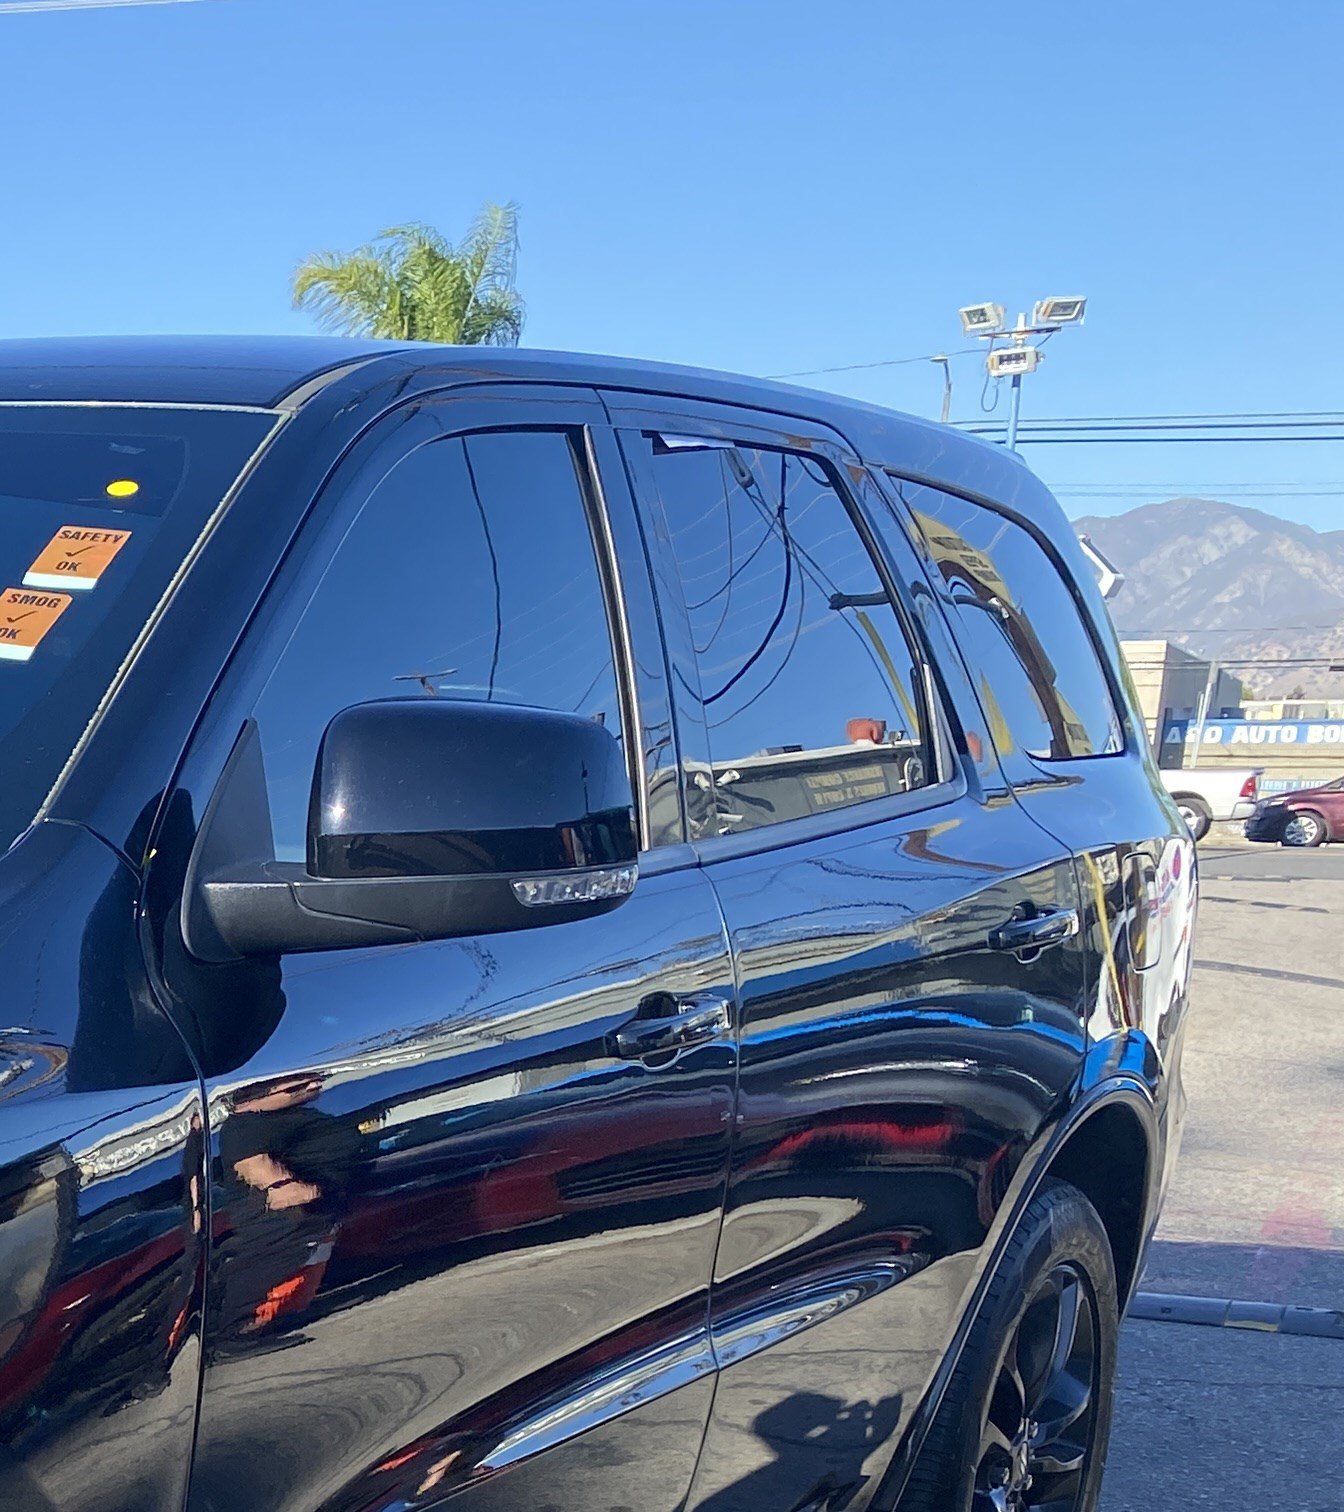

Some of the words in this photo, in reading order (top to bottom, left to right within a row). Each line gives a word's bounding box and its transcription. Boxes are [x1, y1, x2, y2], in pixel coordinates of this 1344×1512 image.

[58, 529, 124, 543] SAFETY
[55, 561, 82, 571] OK
[6, 593, 62, 608] SMOG
[1230, 725, 1298, 744] AUTO
